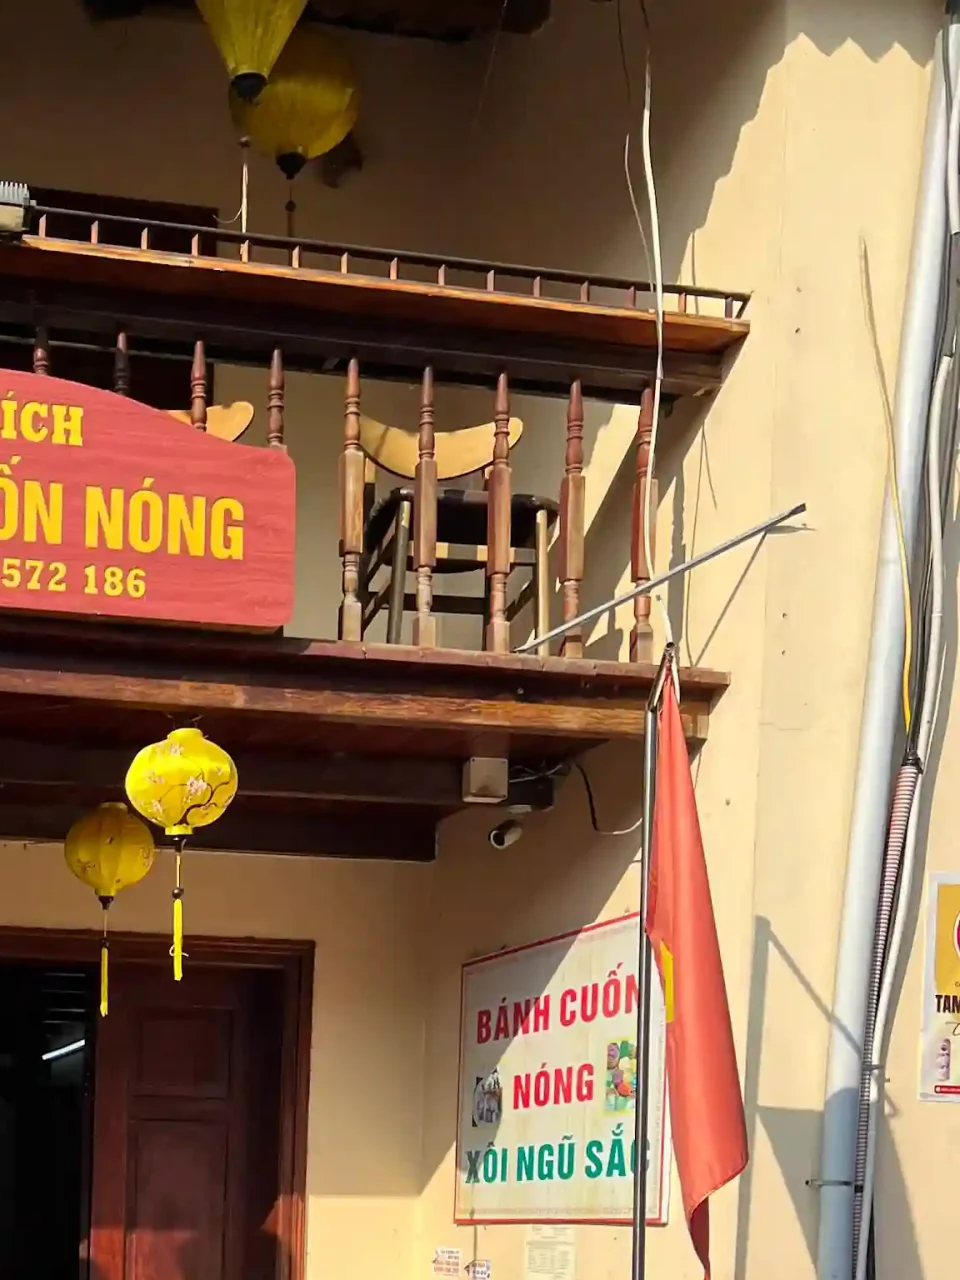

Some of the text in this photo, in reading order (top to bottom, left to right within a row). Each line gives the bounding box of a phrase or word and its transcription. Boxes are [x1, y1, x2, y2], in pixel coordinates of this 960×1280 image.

[84, 477, 245, 561] NÓNG
[1, 559, 68, 592] 572
[84, 566, 147, 599] 186
[476, 962, 641, 1044] BÁNH CUỐN
[512, 1062, 595, 1110] NÓNG
[465, 1141, 508, 1184] XÔI
[515, 1135, 576, 1183] NGŨ
